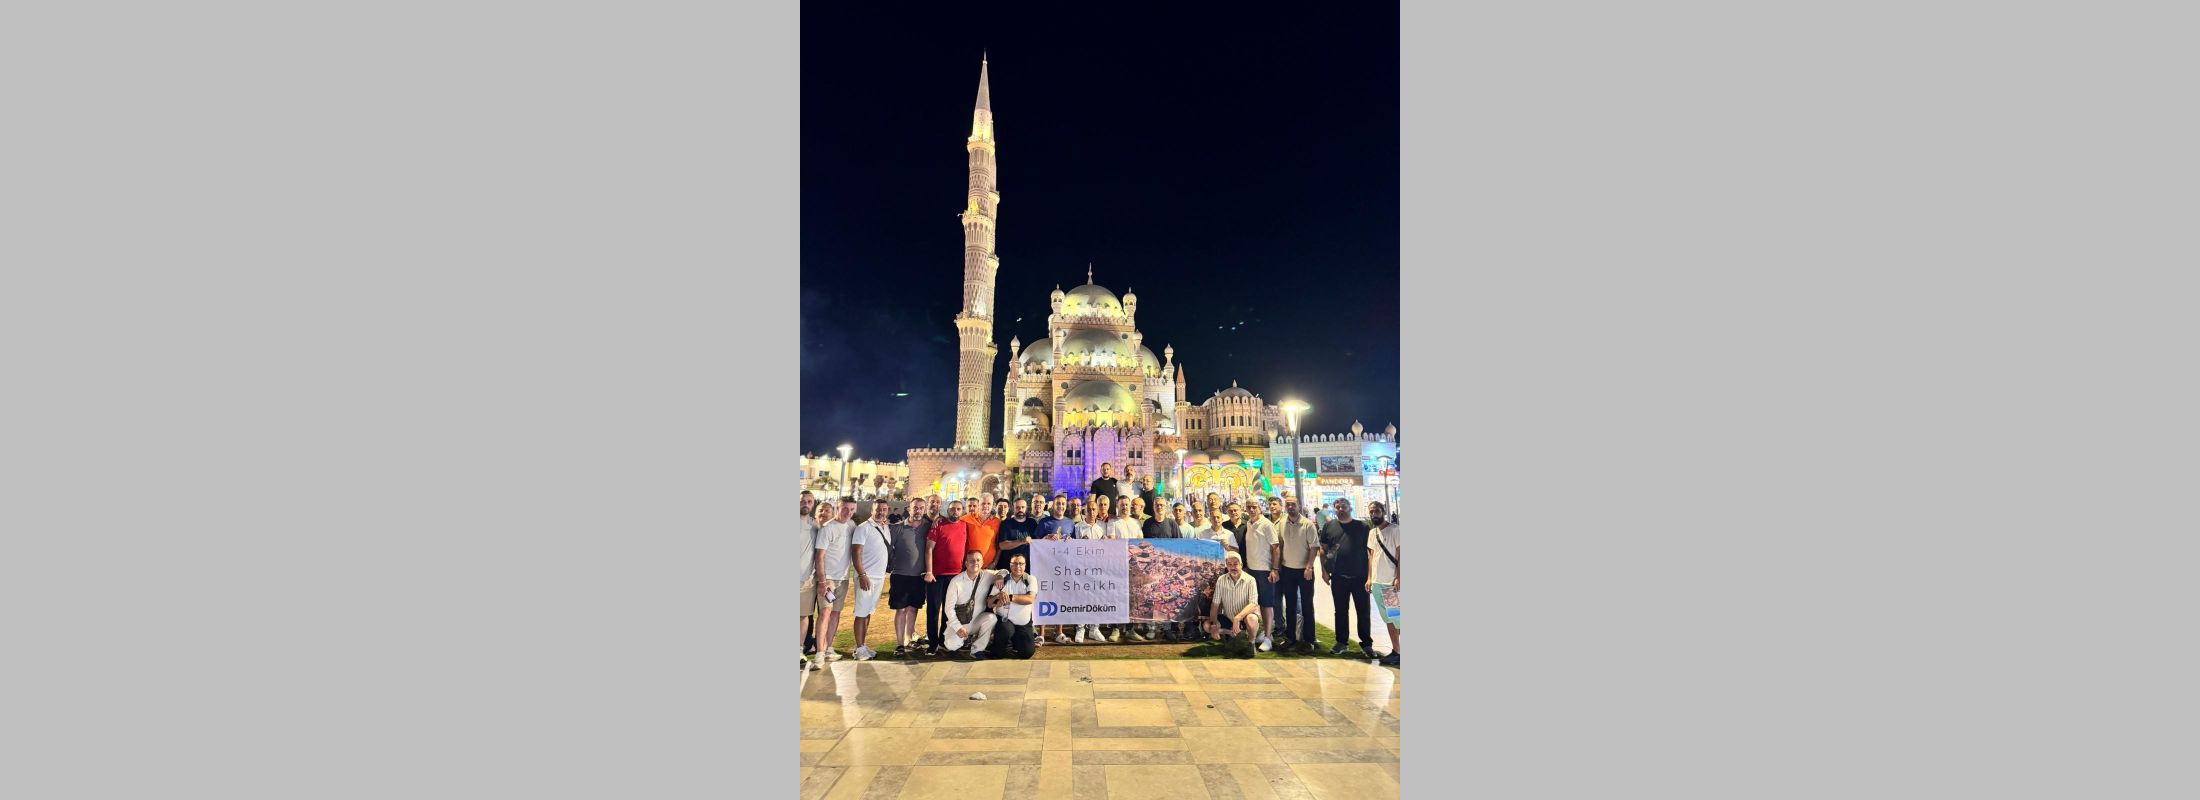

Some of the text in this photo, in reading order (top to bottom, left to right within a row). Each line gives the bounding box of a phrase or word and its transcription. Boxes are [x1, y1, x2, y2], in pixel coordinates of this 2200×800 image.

[1076, 546, 1105, 556] Ekim
[1054, 565, 1102, 576] Sharm
[1040, 580, 1116, 591] El Sheikh
[1060, 604, 1117, 613] DemirDöküm
